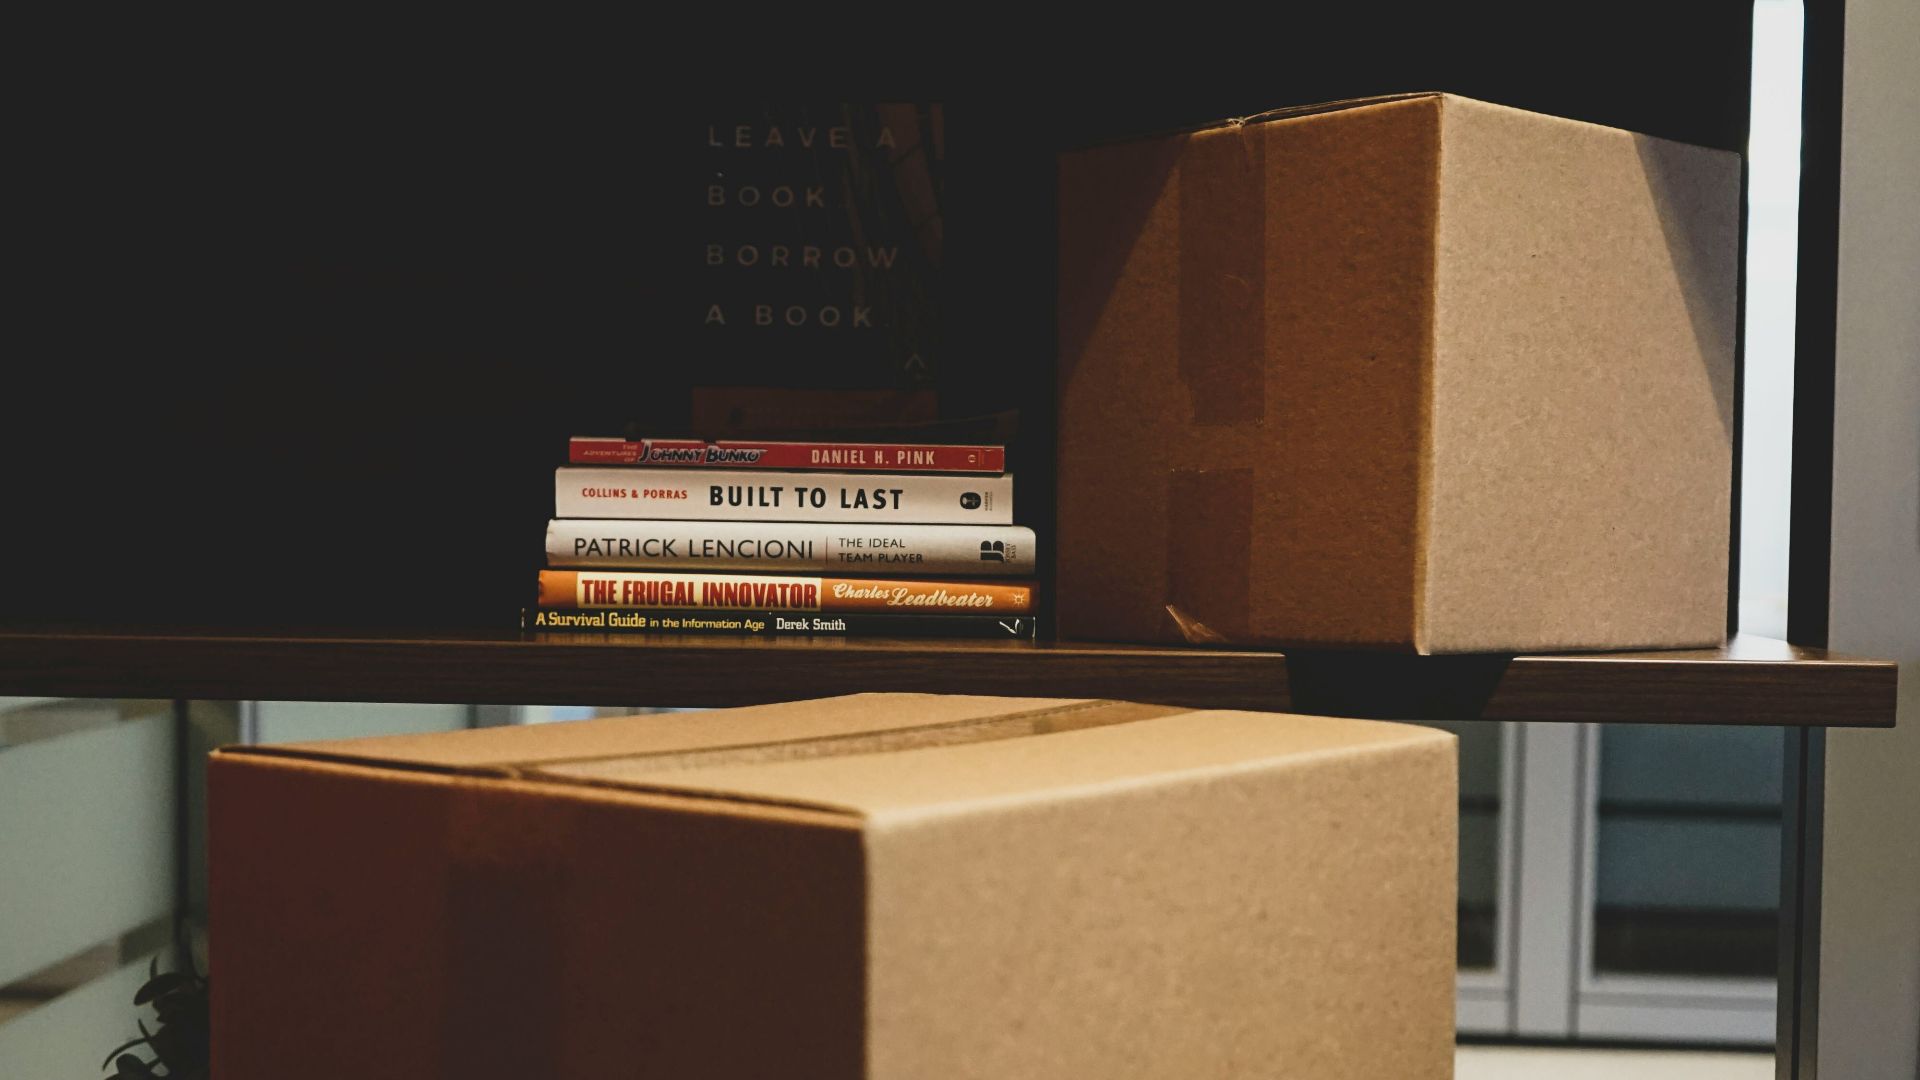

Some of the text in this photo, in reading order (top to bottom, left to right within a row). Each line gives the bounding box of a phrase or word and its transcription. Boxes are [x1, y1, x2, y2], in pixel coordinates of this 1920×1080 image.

[708, 126, 897, 149] LEAVE A
[707, 186, 825, 207] BOOK
[706, 245, 898, 269] BORROW
[705, 304, 873, 328] A BOOK
[639, 441, 768, 464] JOHNNY BUNKO
[811, 450, 935, 466] DANIEL H. PINK
[581, 487, 688, 500] COLLINS & PORRAS
[709, 485, 904, 510] BUILT TO LAST
[574, 538, 813, 559] PATRICK LENCIONI
[839, 537, 906, 549] THE IDEAL
[839, 552, 923, 564] TEAM PLAYER
[581, 579, 819, 609] THE FRUGAL INNOVATOR
[832, 583, 994, 608] Charles Leadbeater
[535, 612, 765, 632] A Survival Guide in the Information Age
[776, 617, 846, 631] Derek Smith
